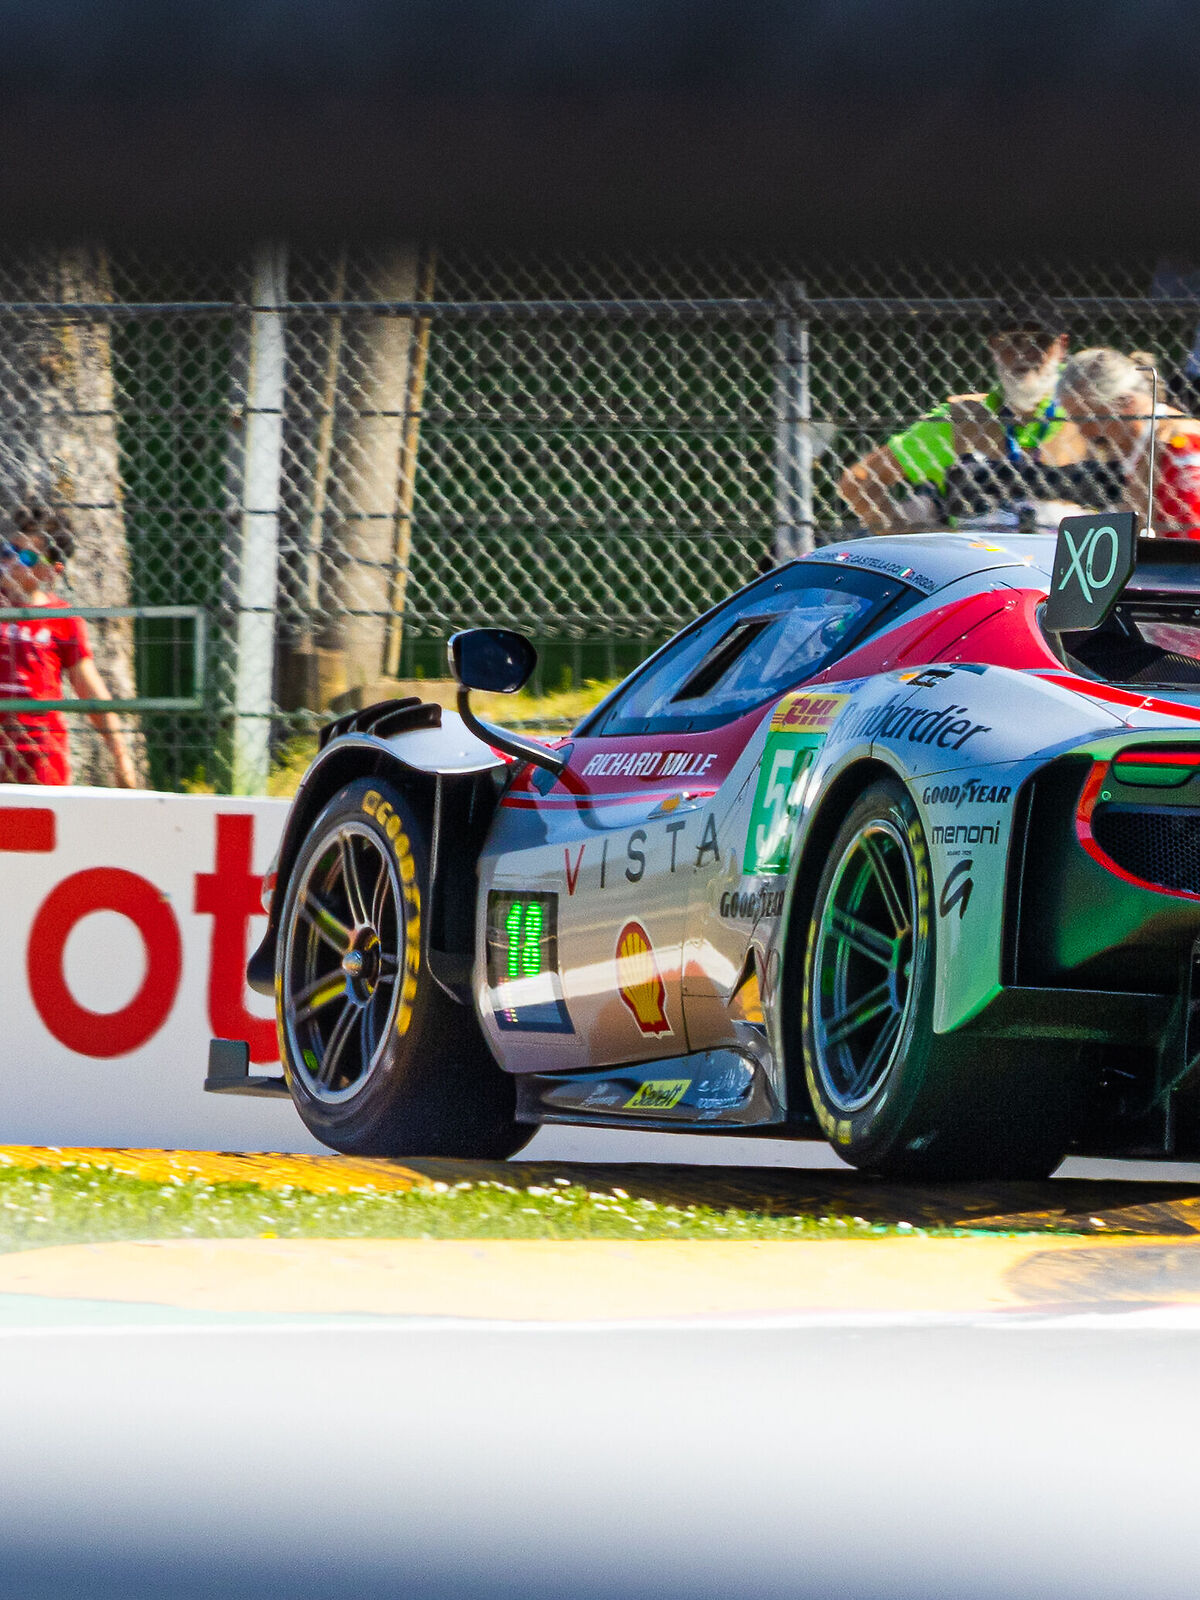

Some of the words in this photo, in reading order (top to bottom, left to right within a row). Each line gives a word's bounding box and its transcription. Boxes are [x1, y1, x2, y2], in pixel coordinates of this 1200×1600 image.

[1058, 526, 1119, 604] XO
[581, 752, 660, 776] RICHARD
[659, 752, 718, 776] MILLE
[922, 778, 1012, 808] GOODYEAR
[932, 820, 1001, 845] menoni
[564, 812, 721, 896] VISTA
